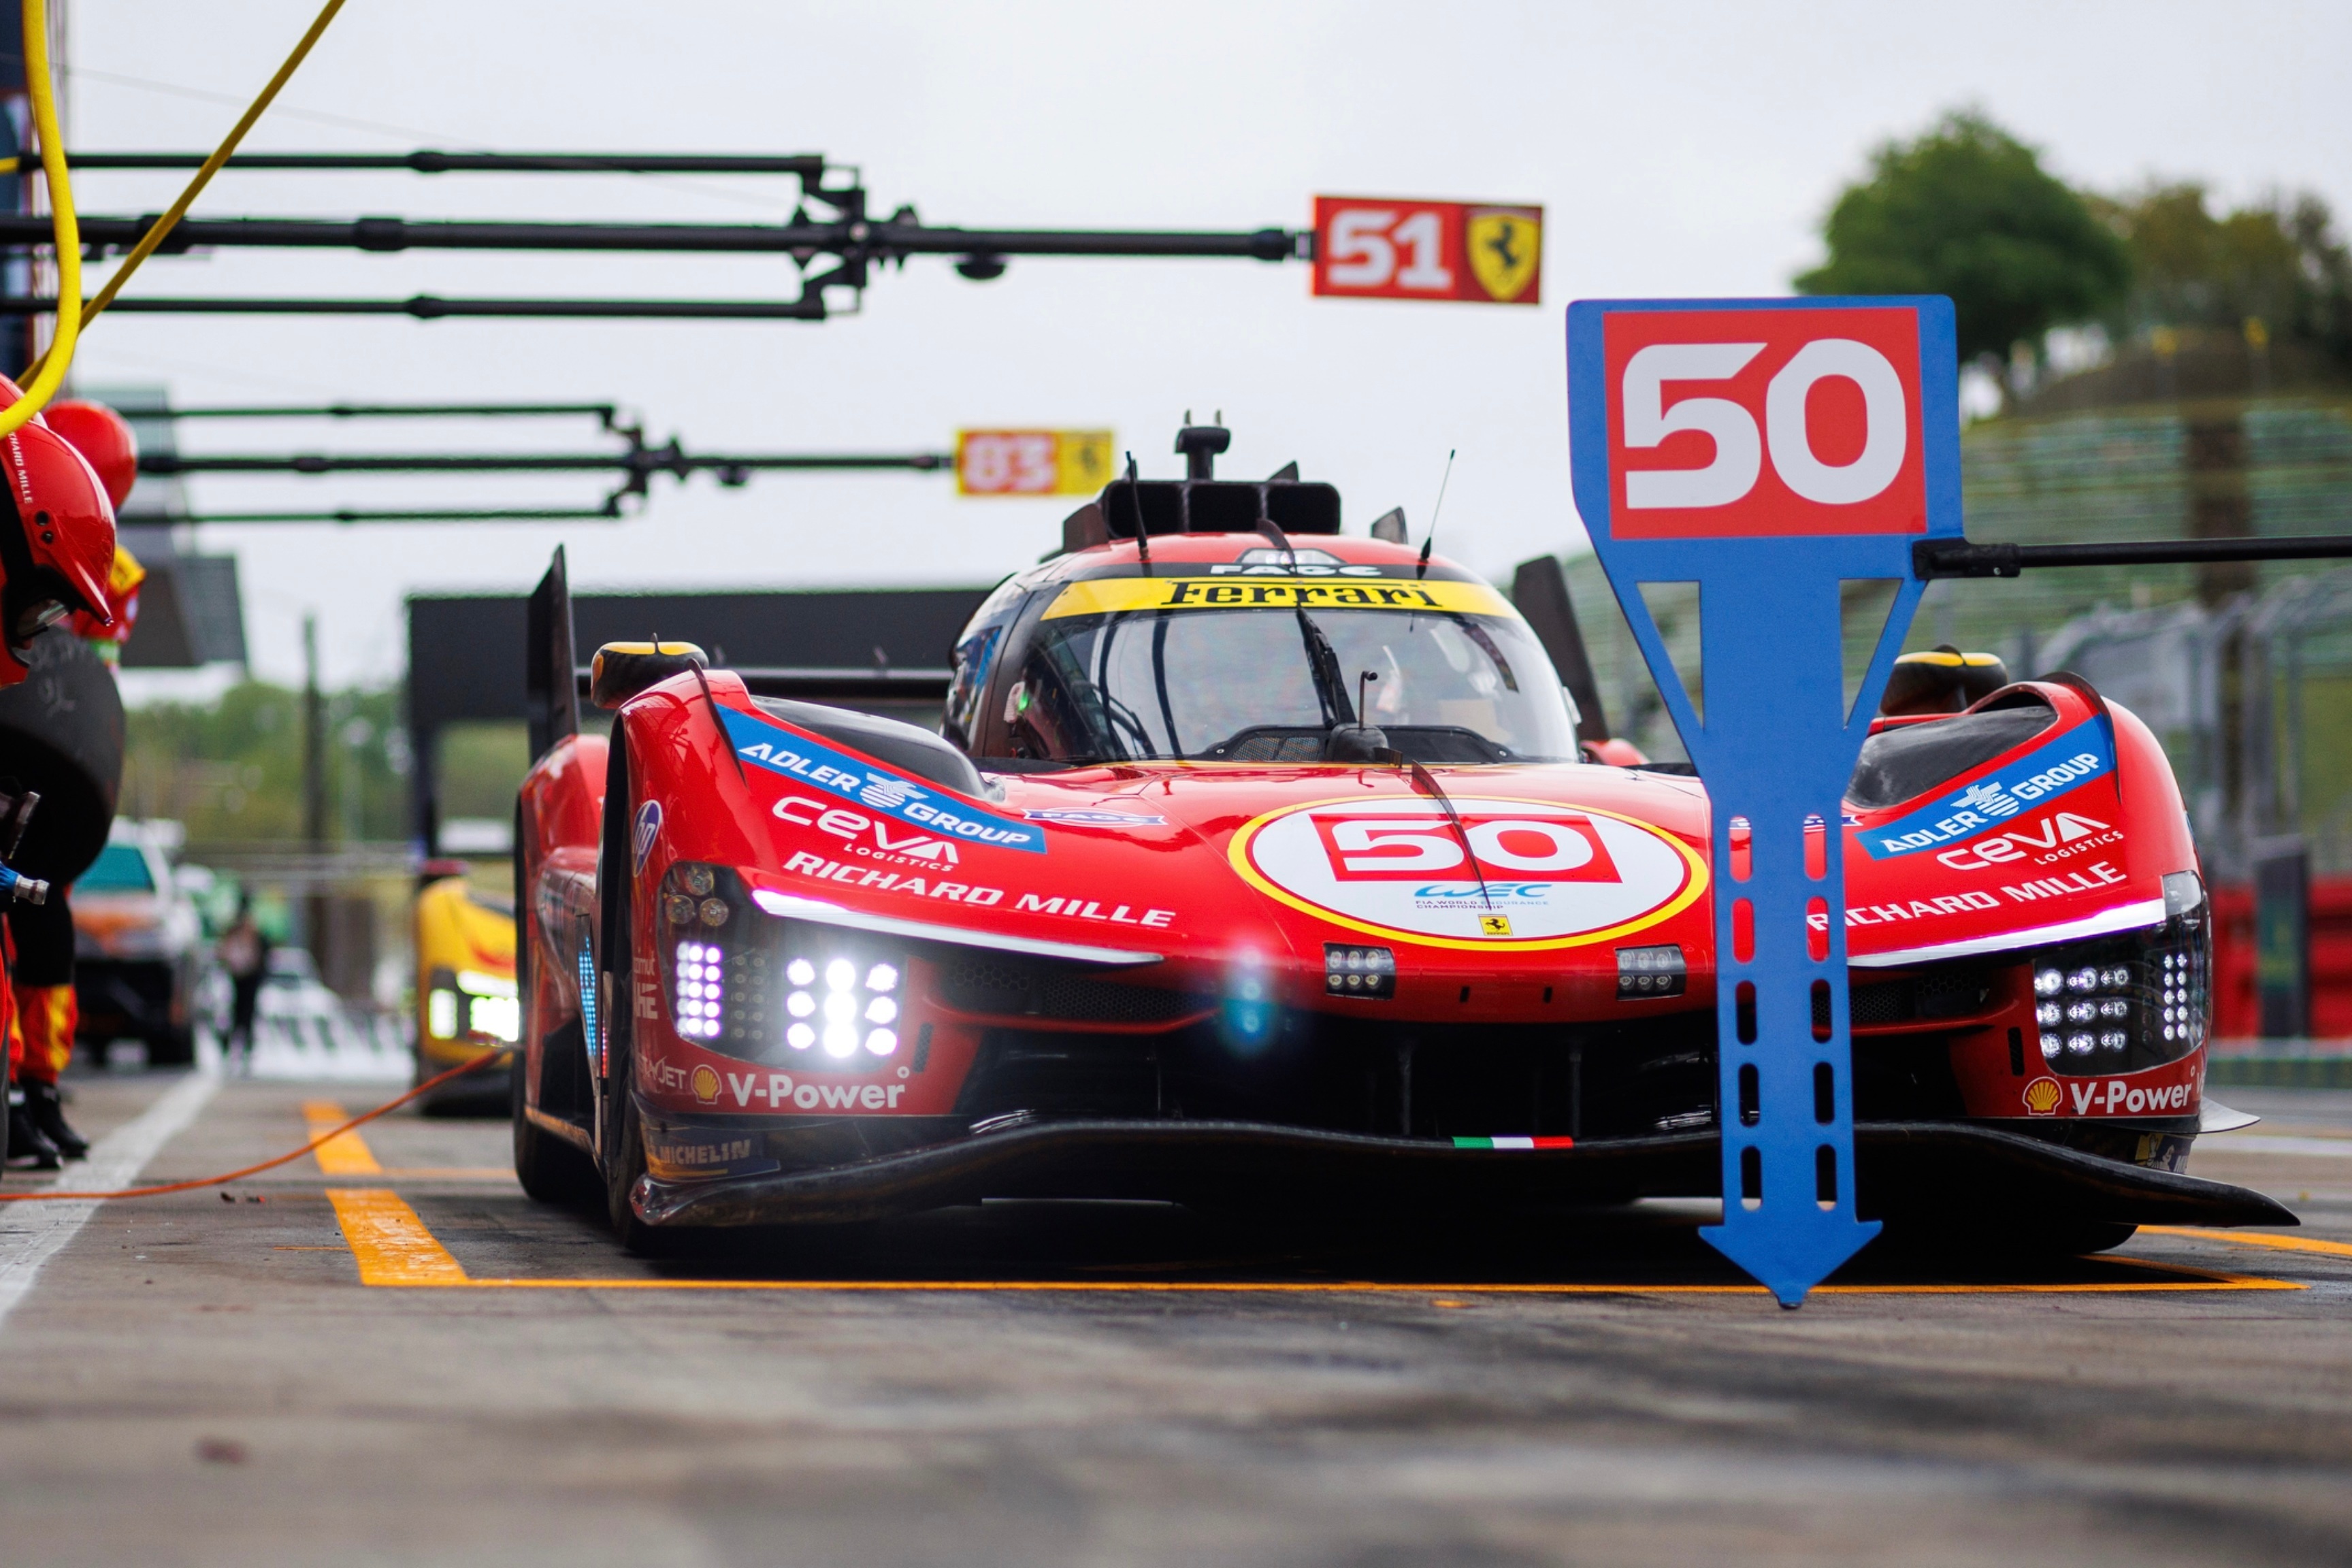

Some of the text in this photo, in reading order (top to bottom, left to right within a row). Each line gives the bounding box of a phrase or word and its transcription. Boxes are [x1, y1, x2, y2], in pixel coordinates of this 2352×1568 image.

[1329, 208, 1452, 290] 51
[1622, 338, 1906, 509] 50
[964, 436, 1054, 491] 83
[17, 470, 33, 504] MILLE
[1160, 581, 1443, 607] Ferrari
[738, 742, 1031, 845] ADLER GROUP
[1880, 753, 2099, 853] ADLER GROUP
[843, 843, 954, 872] LOGISTICS
[1331, 819, 1594, 871] 50
[2034, 830, 2124, 865] LOGISTICS
[783, 851, 1176, 928] RICHARD MILLE
[1414, 883, 1552, 898] WEC
[2001, 861, 2128, 902] MILLE
[727, 1073, 906, 1109] V-Power
[2070, 1080, 2192, 1115] V-Power
[659, 1139, 751, 1165] MICHELIN
